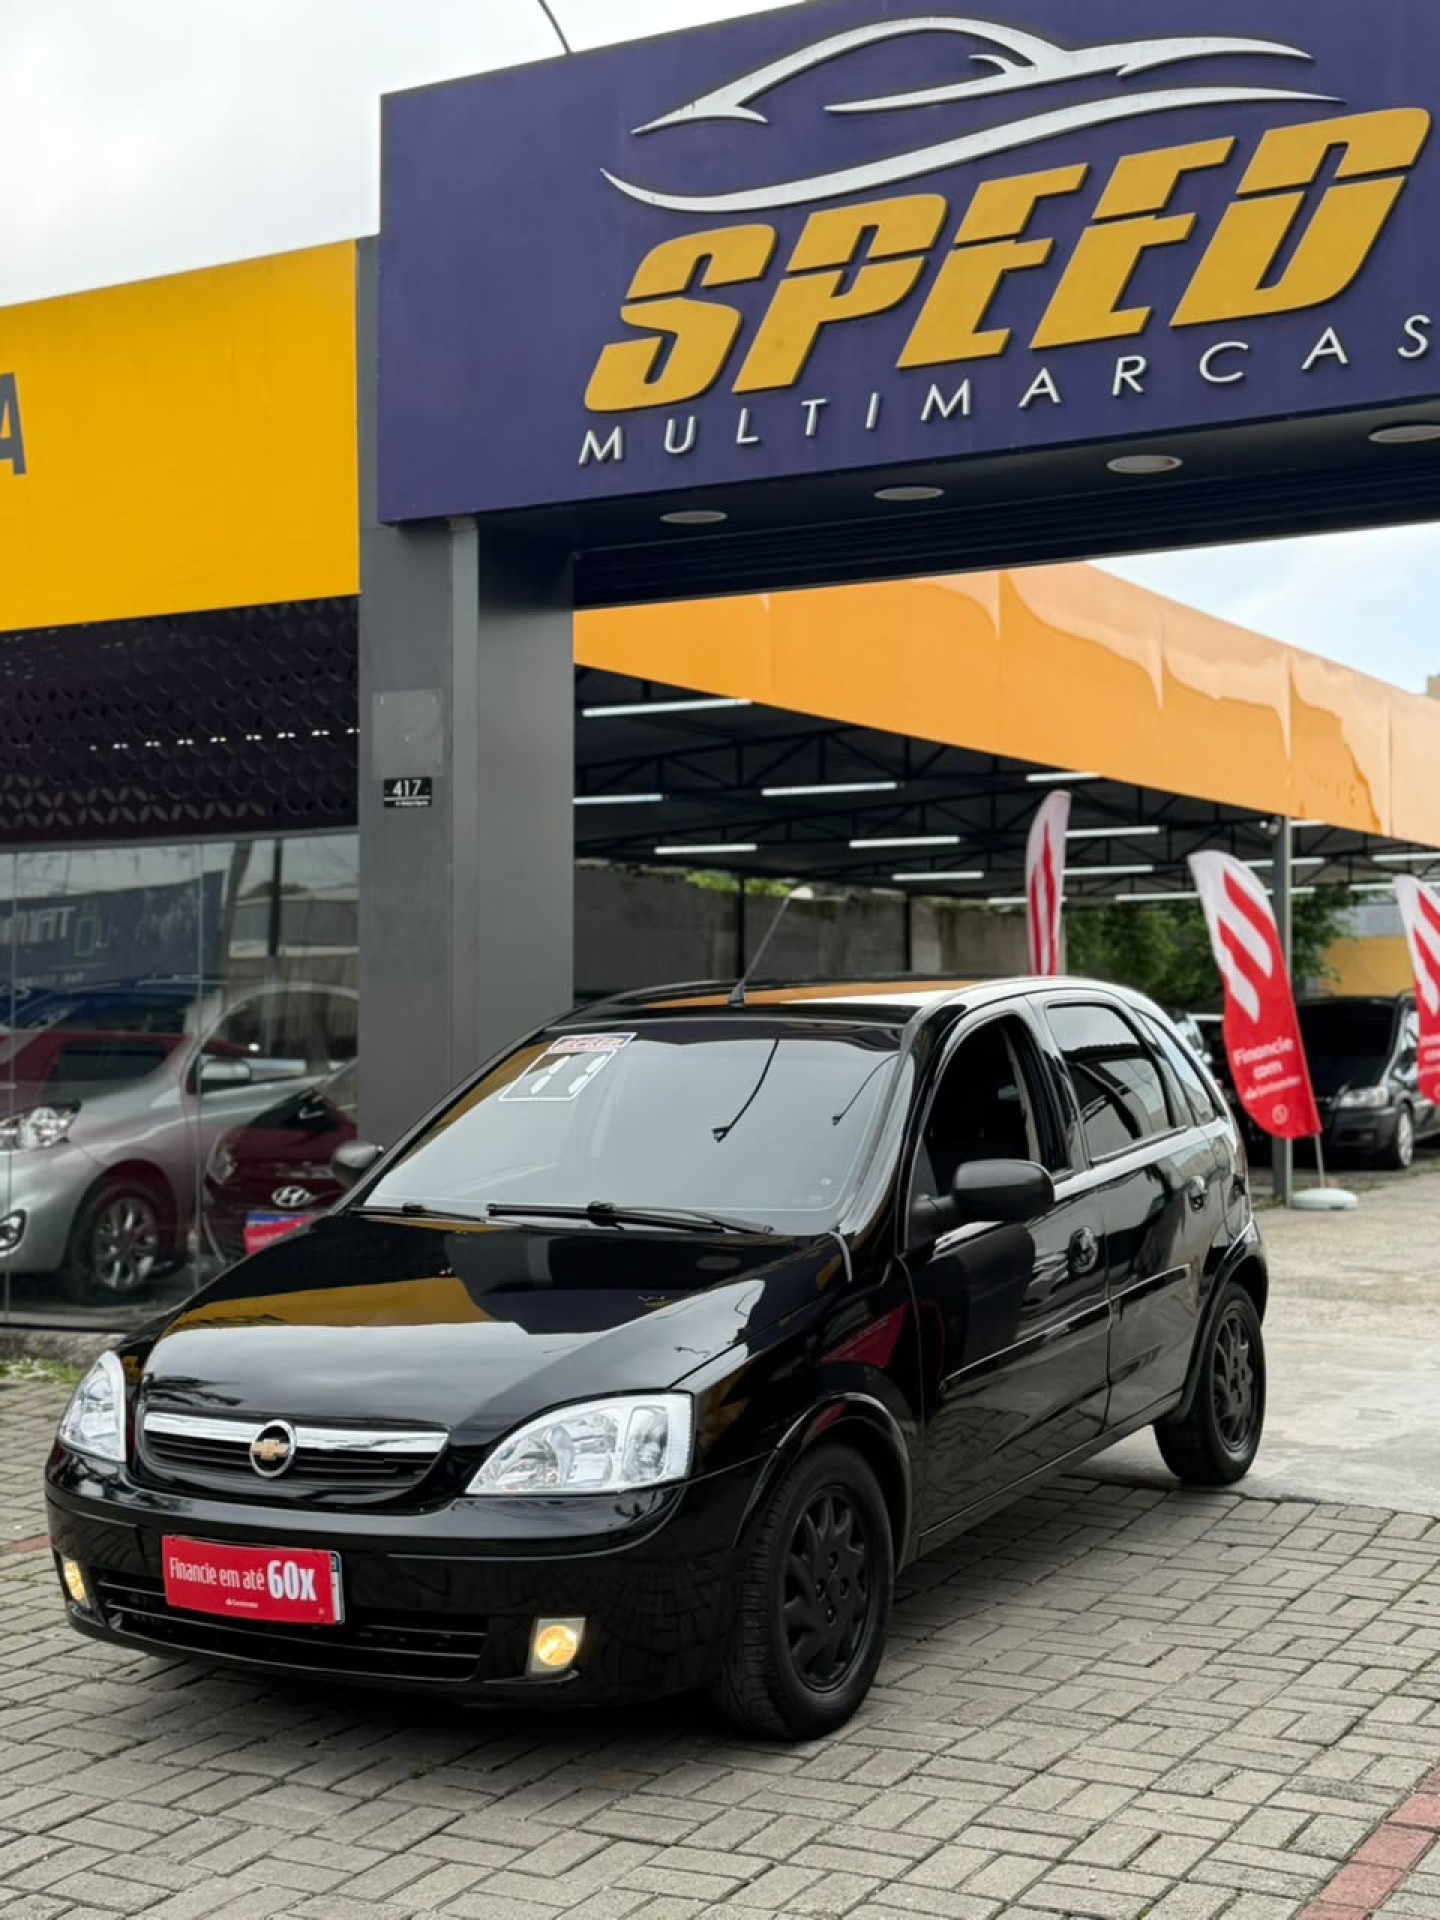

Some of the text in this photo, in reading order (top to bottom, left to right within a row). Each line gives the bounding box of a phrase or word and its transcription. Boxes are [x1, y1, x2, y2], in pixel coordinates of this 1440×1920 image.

[585, 108, 1431, 413] SPEED
[578, 314, 1431, 464] MULTIMARCAS
[392, 779, 422, 796] 417
[1232, 1036, 1294, 1066] Financie
[169, 1557, 317, 1601] Financie em até 60x
